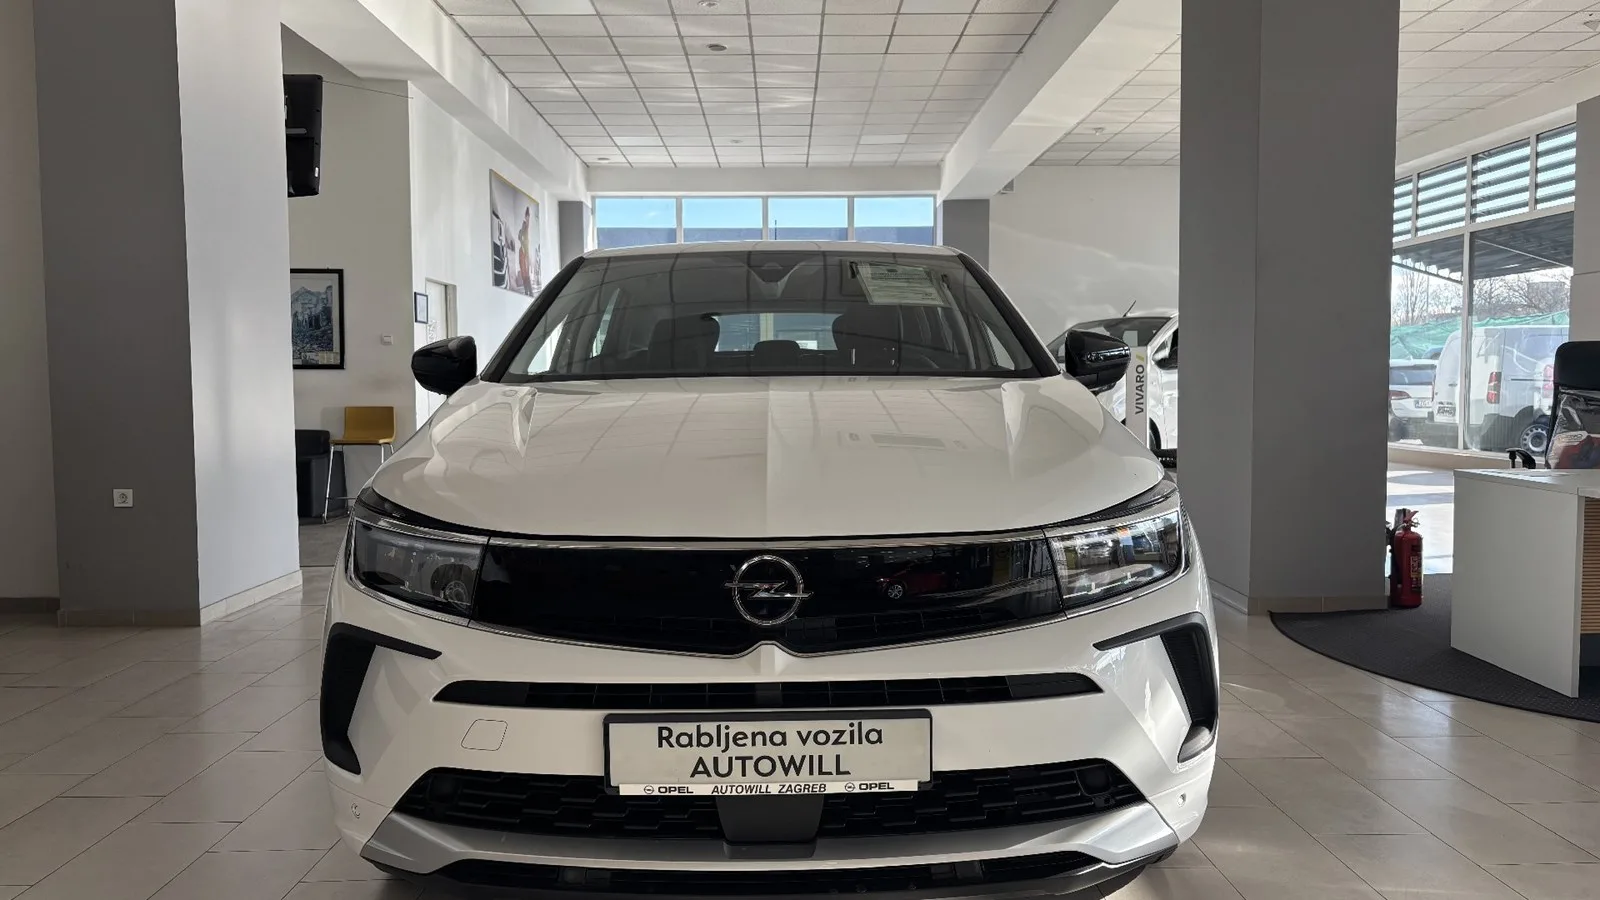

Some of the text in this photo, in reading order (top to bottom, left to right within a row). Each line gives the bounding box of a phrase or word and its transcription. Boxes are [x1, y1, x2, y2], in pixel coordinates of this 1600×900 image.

[1135, 364, 1145, 415] VIVARO
[657, 721, 883, 753] Rabljena vozila
[690, 754, 851, 778] AUTOWILL
[658, 782, 894, 795] OPEL AUTOWILL ZAGREB OPEL
